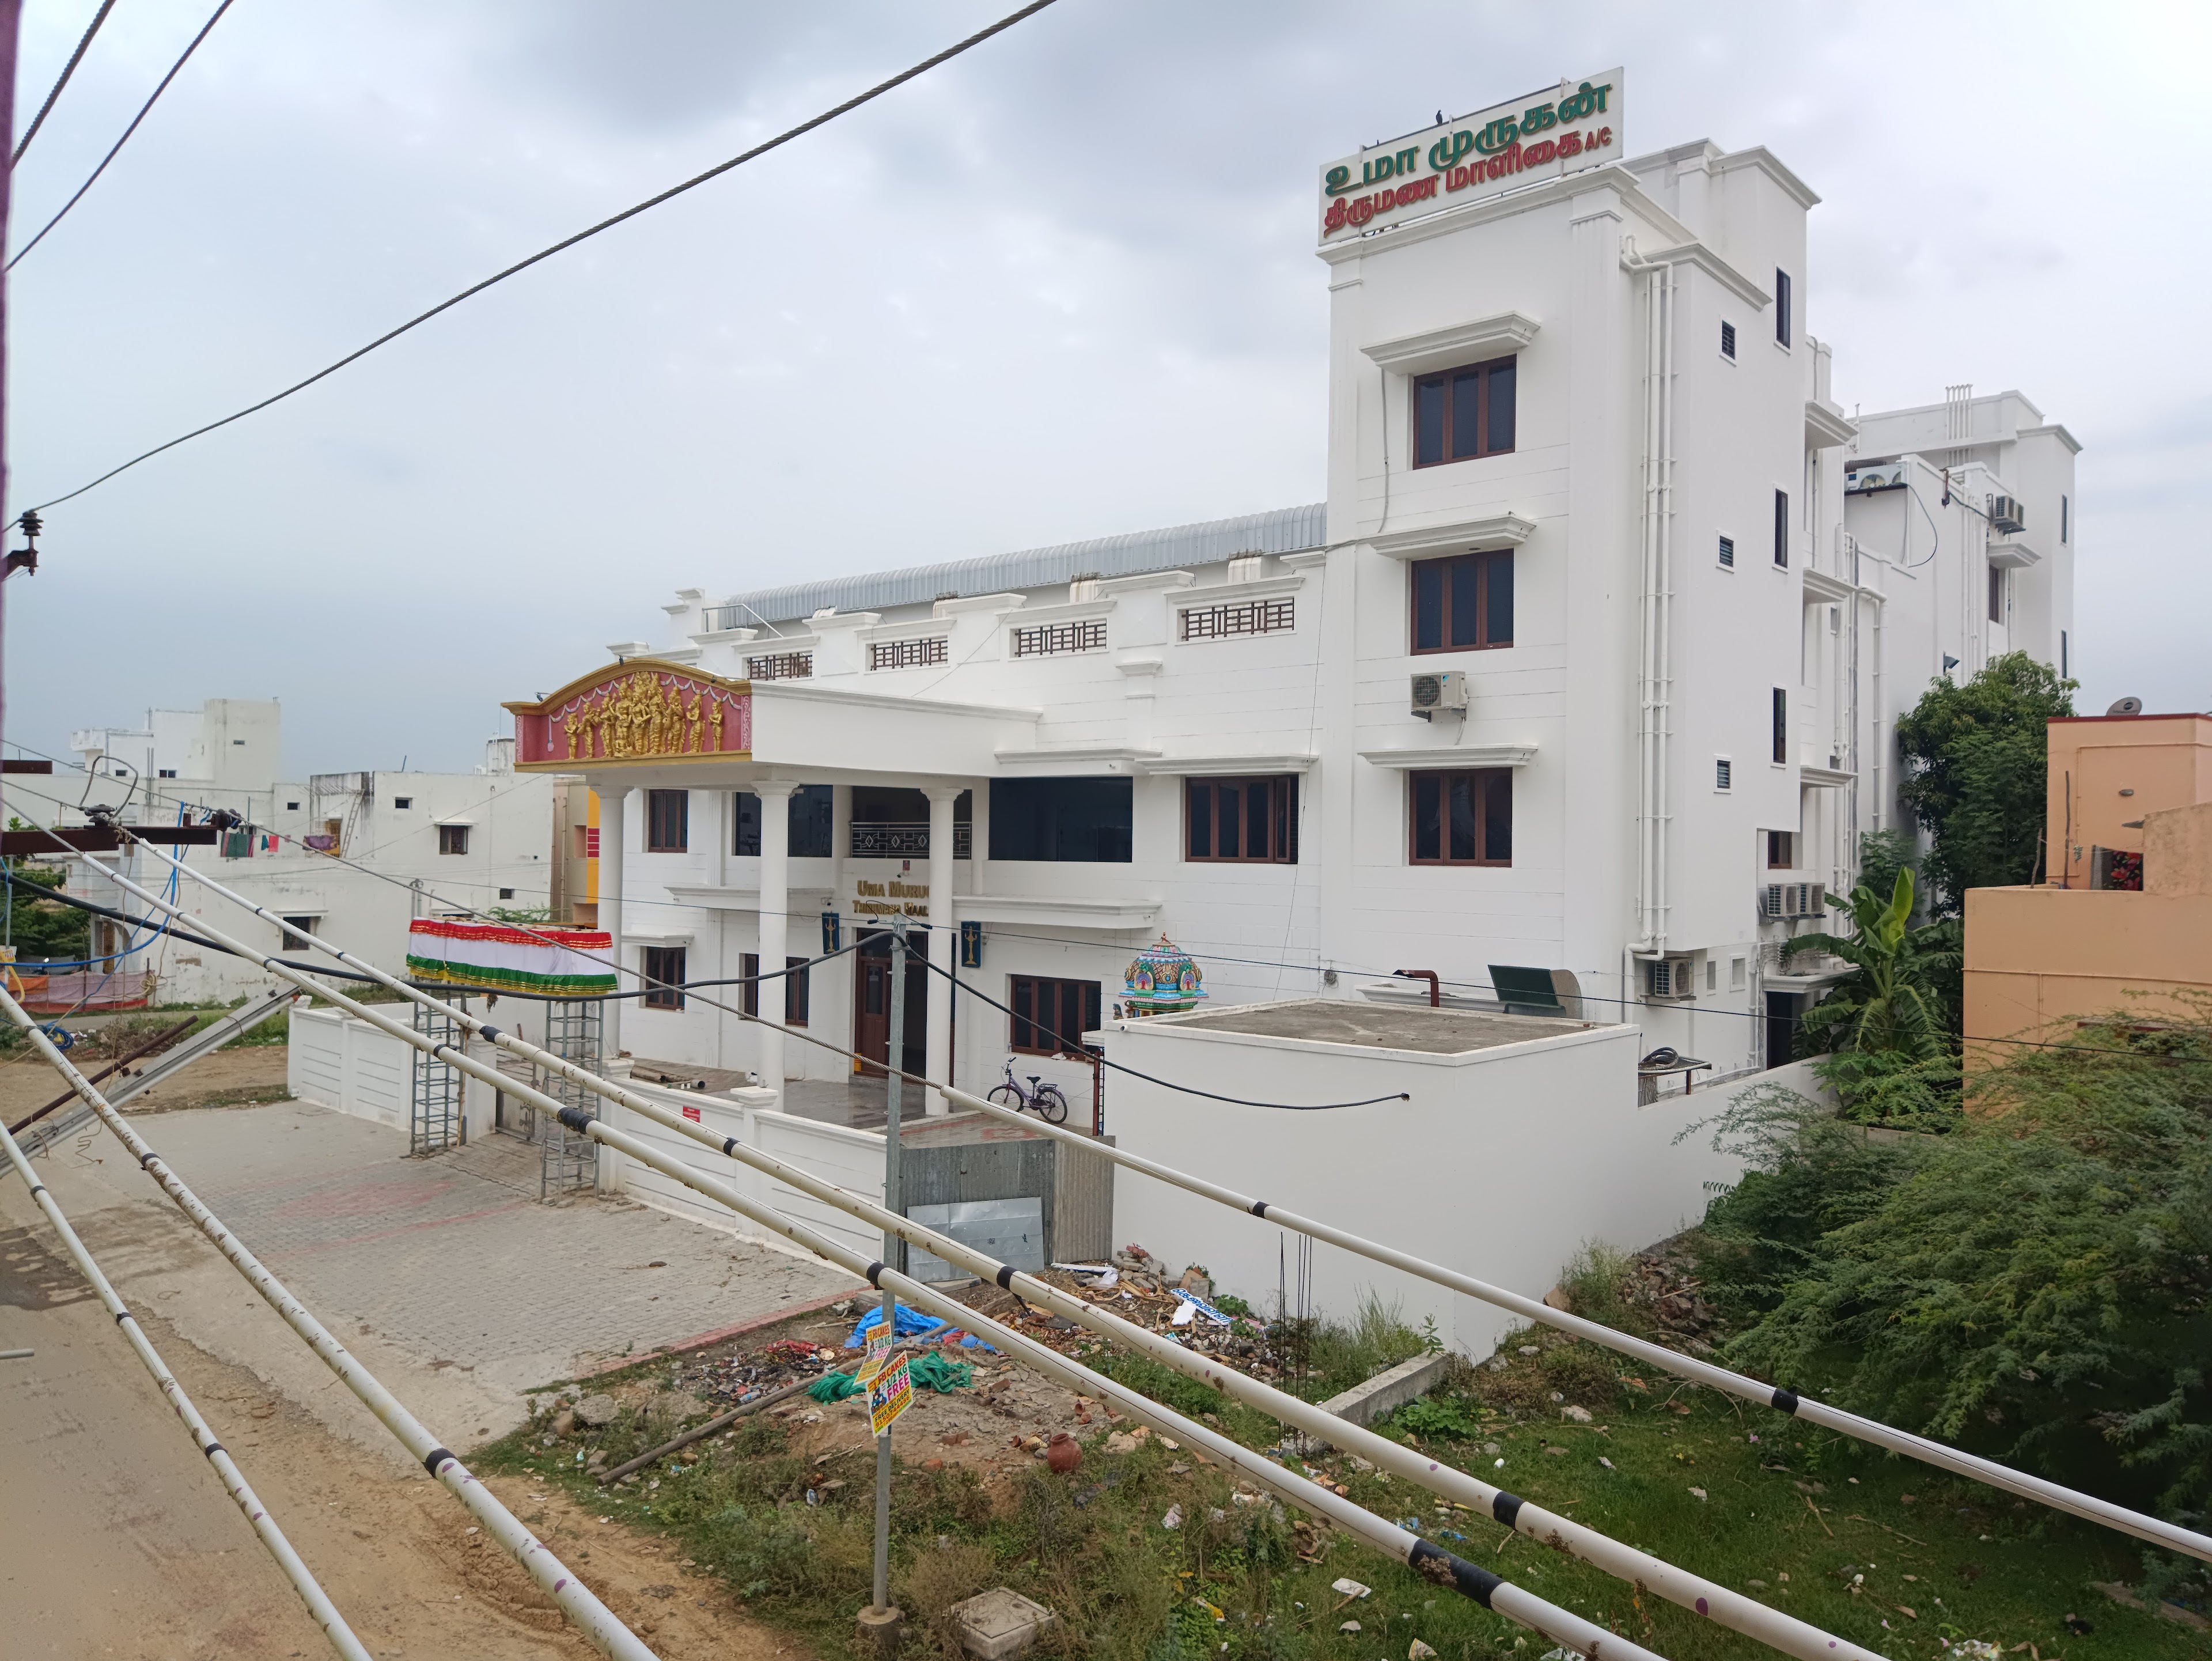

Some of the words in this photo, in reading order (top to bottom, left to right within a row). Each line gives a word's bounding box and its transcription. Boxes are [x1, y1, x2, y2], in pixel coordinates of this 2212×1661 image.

[1325, 145, 1421, 196] உமா
[1429, 81, 1612, 171] முருகன்
[1323, 174, 1440, 238] திருமண
[1446, 130, 1583, 192] மாளிகை
[1585, 126, 1612, 151] A/C
[878, 1325, 889, 1337] CAKES
[885, 1335, 891, 1346] KG
[873, 1346, 891, 1360] FREE
[887, 1354, 906, 1376] CAKES
[887, 1374, 897, 1388] 1/2
[898, 1364, 907, 1378] KG
[887, 1372, 909, 1401] FREE
[875, 1409, 887, 1422] FREE
[888, 1388, 909, 1411] DELIVERY
